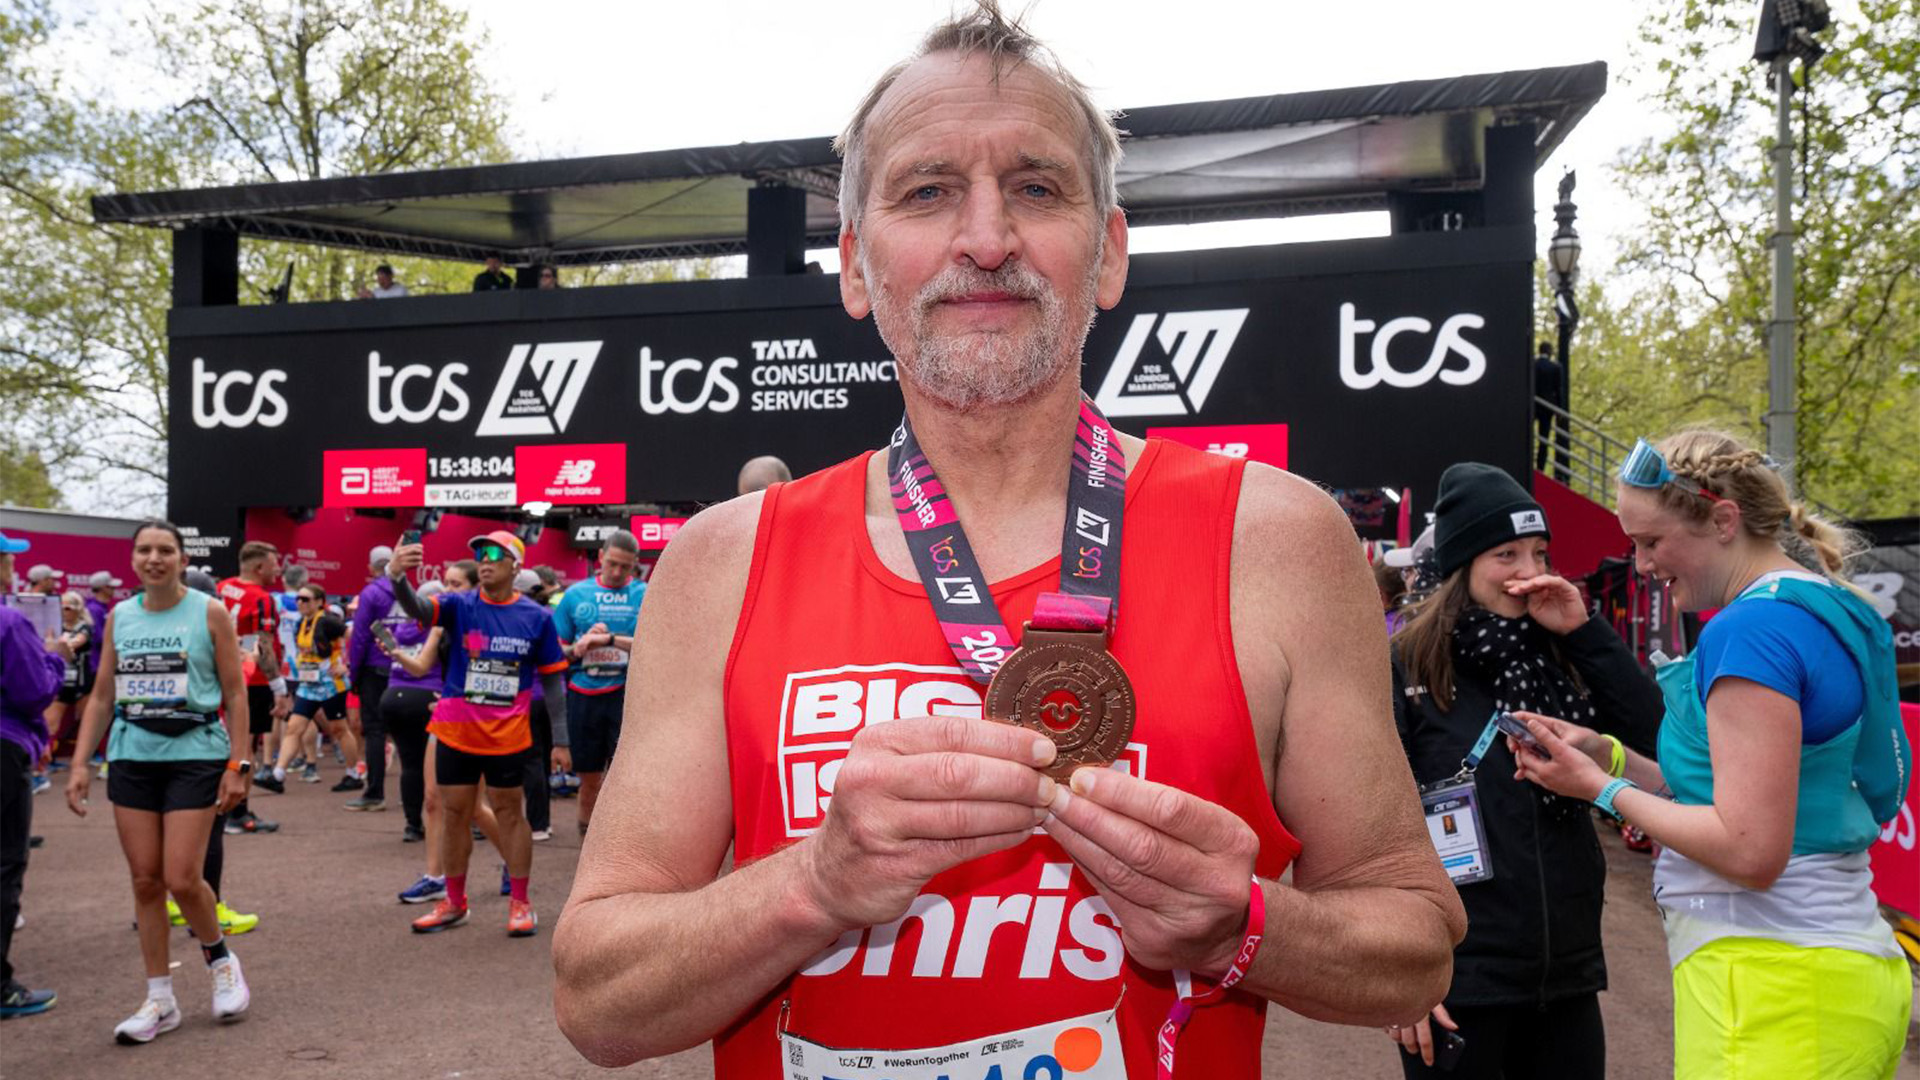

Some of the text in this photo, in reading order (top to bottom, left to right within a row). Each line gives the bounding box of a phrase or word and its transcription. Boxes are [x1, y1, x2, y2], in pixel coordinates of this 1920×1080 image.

[752, 339, 817, 361] TATA
[1340, 302, 1487, 390] tcs
[640, 346, 740, 415] tcs
[1133, 374, 1170, 383] LONDON
[1142, 365, 1162, 374] TCS
[192, 357, 288, 429] tcs
[368, 351, 470, 424] tcs
[1128, 382, 1176, 392] MARATHON
[751, 388, 849, 411] SERVICES
[429, 456, 515, 477] 15:38:04
[1088, 425, 1108, 488] FINISHER
[900, 461, 936, 528] FINISHER
[929, 536, 958, 574] tcs
[1073, 547, 1102, 579] tcs
[595, 592, 628, 604] TOM
[123, 636, 183, 650] SERENA
[127, 680, 176, 696] 55442
[474, 676, 510, 692] 58128
[792, 678, 983, 737] BIG
[1238, 935, 1262, 964] tcs
[838, 1056, 856, 1068] tcs
[884, 1051, 970, 1069] #WeRunTogether
